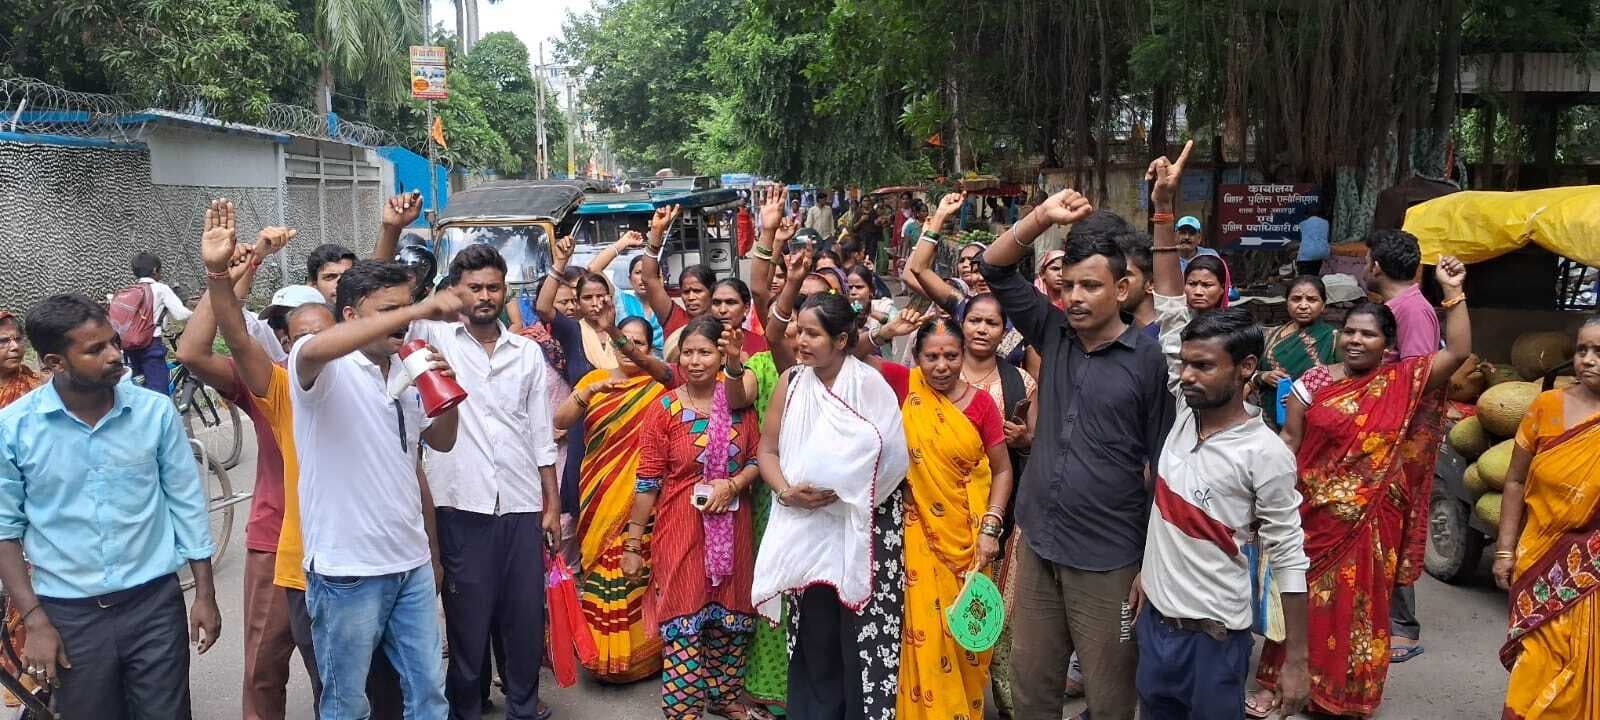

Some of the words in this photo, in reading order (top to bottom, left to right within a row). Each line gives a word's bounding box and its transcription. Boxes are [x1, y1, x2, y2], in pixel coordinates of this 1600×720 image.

[1247, 183, 1294, 193] कार्यालय
[1248, 193, 1272, 205] पुलिस
[1256, 214, 1274, 224] एवं
[1222, 221, 1242, 233] पुलिस
[1246, 222, 1291, 232] पदाधिकारी
